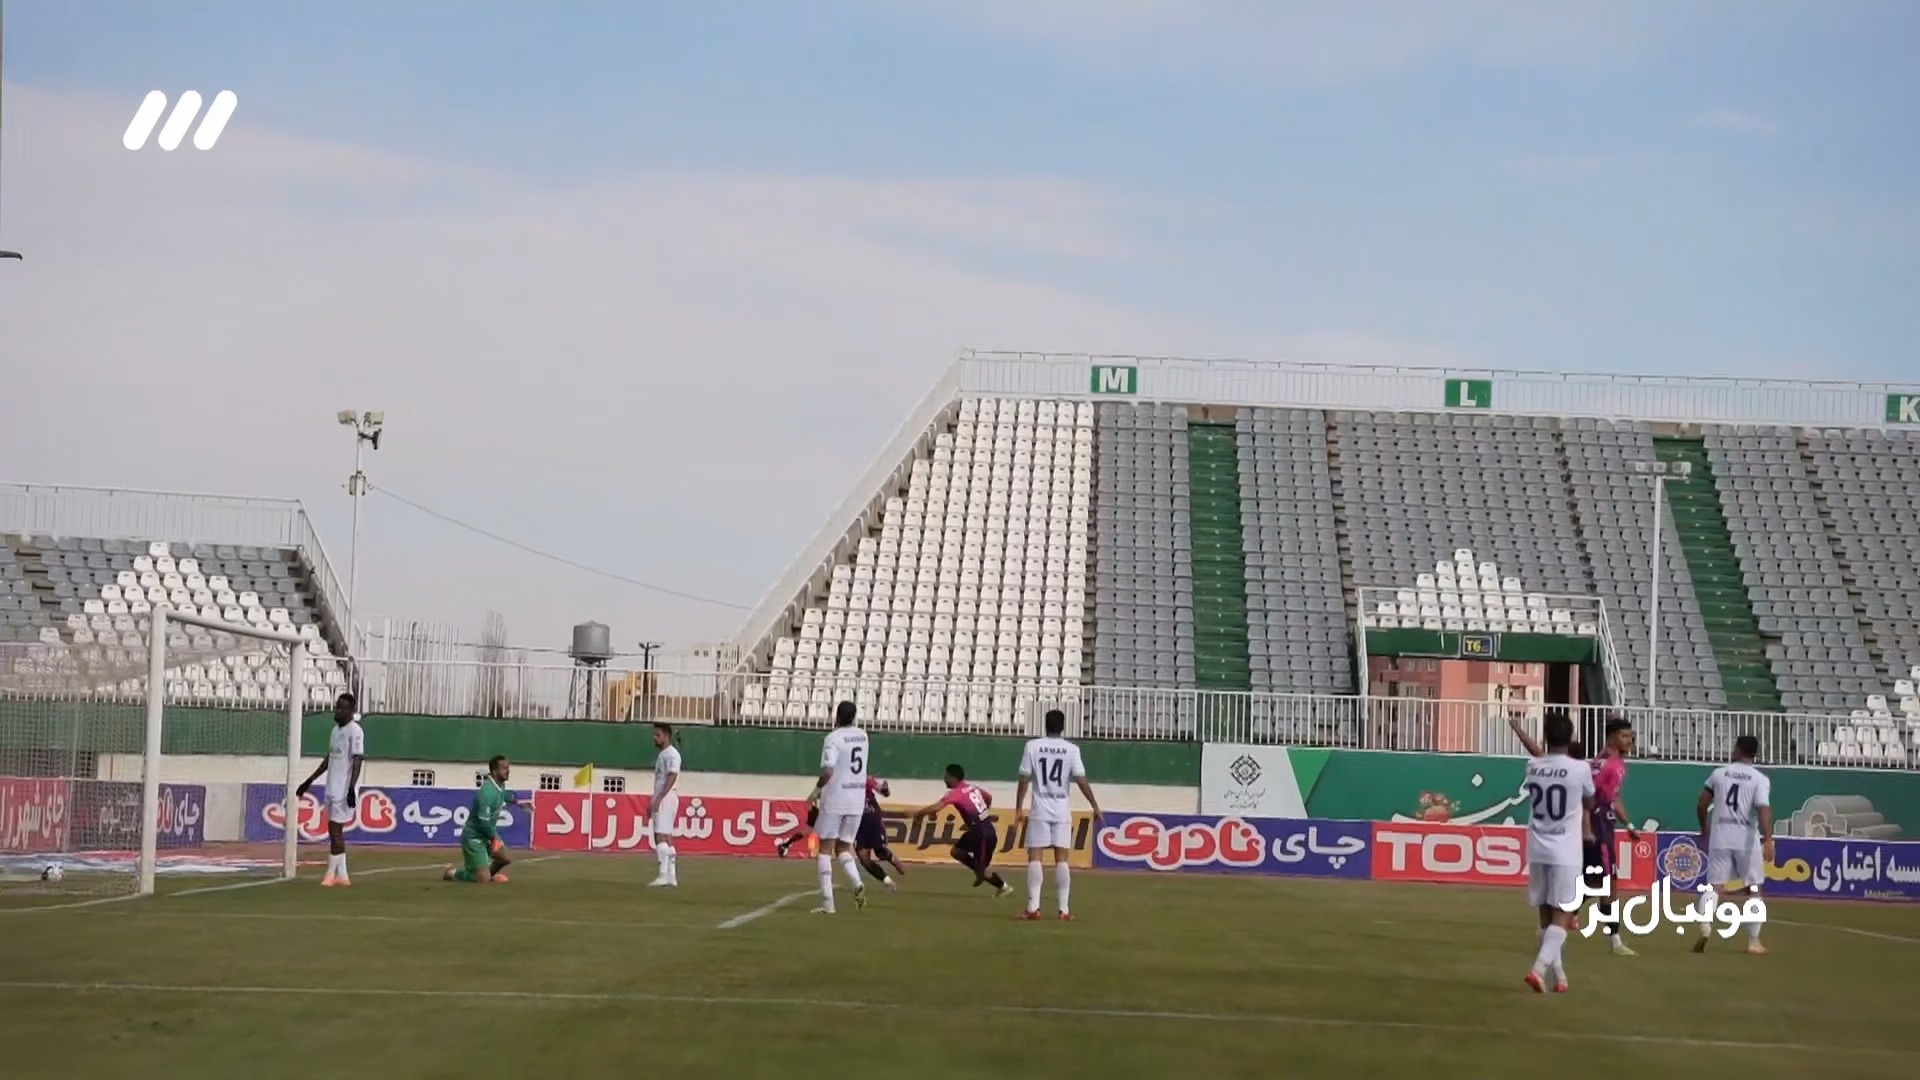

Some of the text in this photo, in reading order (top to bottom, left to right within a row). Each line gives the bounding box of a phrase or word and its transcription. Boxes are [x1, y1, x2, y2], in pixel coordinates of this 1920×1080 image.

[1099, 367, 1128, 392] M
[1460, 381, 1477, 407] L
[1900, 396, 1920, 421] K
[850, 746, 863, 775] 5
[1038, 757, 1064, 787] 14
[1529, 767, 1568, 778] MAJID
[1528, 782, 1567, 821] 20
[1726, 783, 1739, 813] 4
[0, 782, 42, 849] شهرزا
[262, 790, 396, 841] ناری
[547, 798, 799, 849] چای شرزاد
[1099, 817, 1264, 870] نادری
[1273, 826, 1366, 869] چای
[1812, 844, 1881, 892] اعتباری
